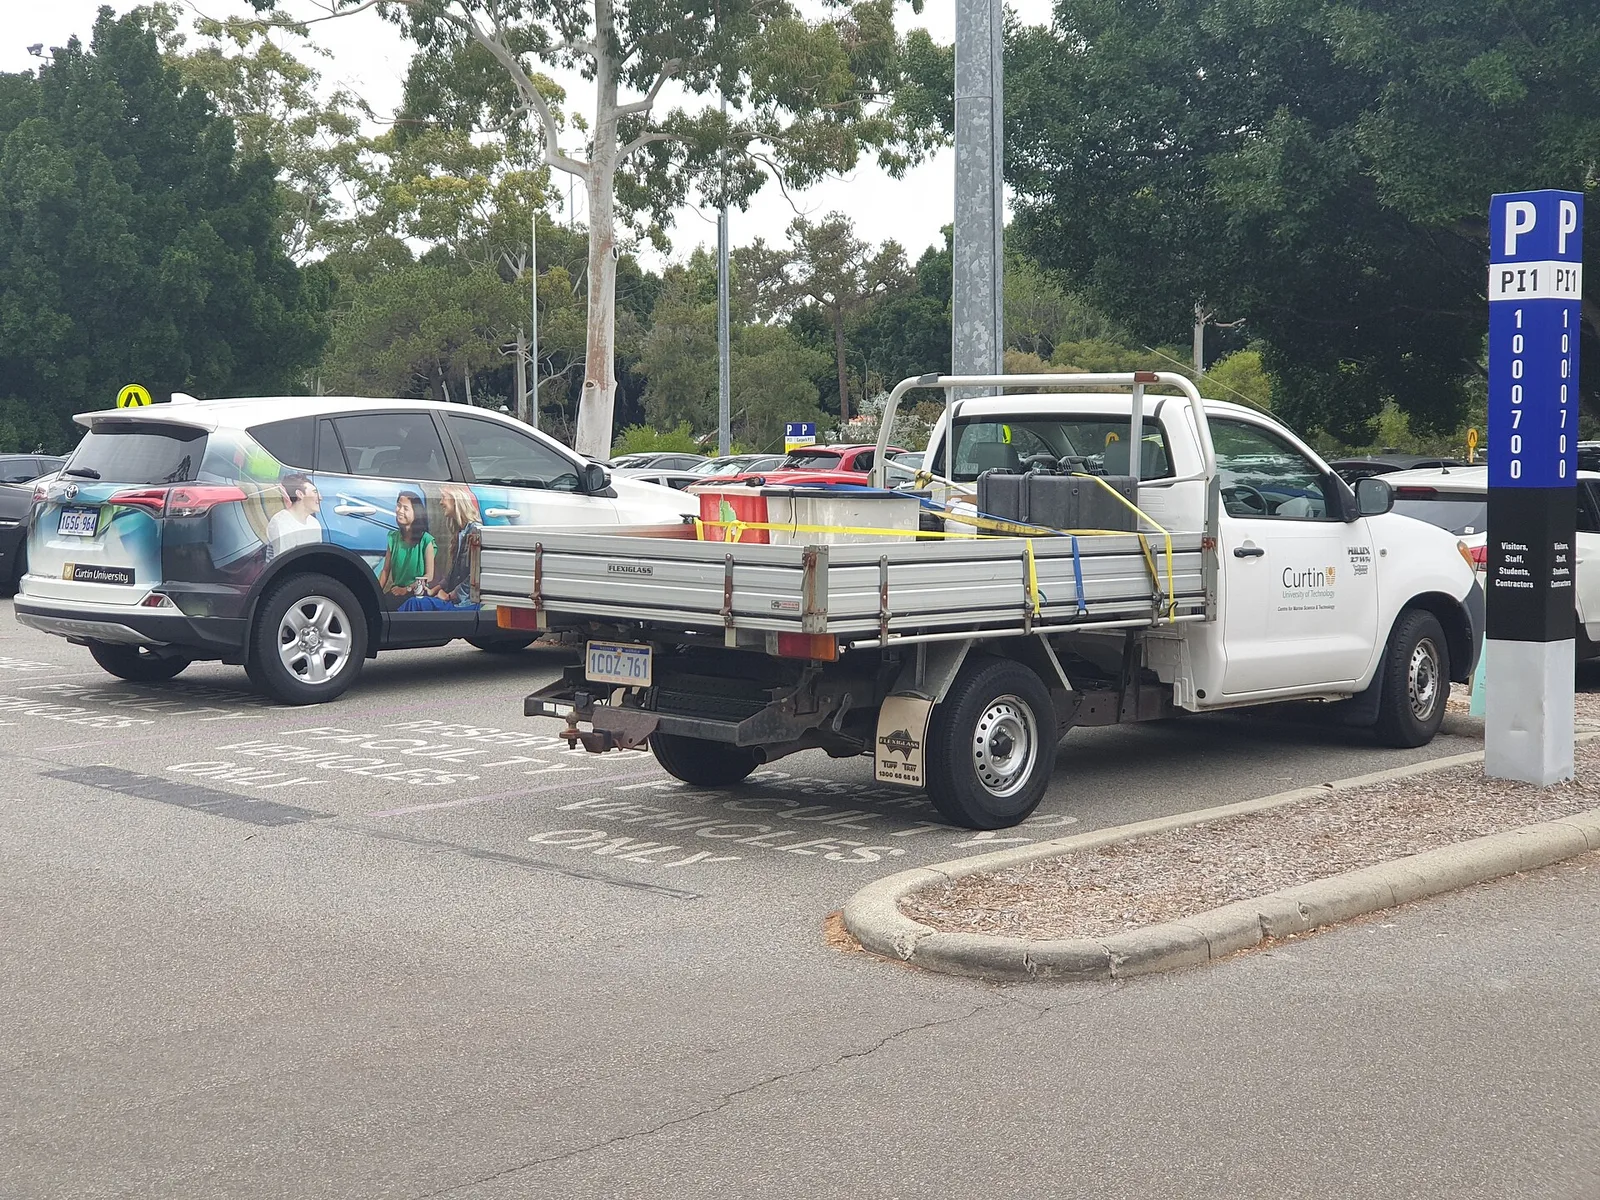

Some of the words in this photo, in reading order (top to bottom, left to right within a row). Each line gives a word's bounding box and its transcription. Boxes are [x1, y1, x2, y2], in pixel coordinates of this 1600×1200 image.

[1504, 201, 1537, 255] P
[1558, 200, 1577, 254] P
[787, 424, 793, 435] P
[802, 424, 807, 435] P
[1501, 542, 1529, 551] Visitors,
[1505, 554, 1524, 564] Staff,
[74, 568, 93, 579] Curtin
[93, 569, 129, 584] University
[608, 565, 652, 574] FLEXIGLASS
[1283, 567, 1325, 588] Curtin
[1499, 566, 1531, 576] Students,
[1495, 579, 1534, 588] Contractors
[1282, 590, 1304, 600] University
[1310, 589, 1335, 599] Technology
[278, 727, 598, 775] FACULTY
[215, 740, 481, 786] VEHICLES
[165, 761, 331, 789] ONLY
[556, 797, 906, 864] VEHICLES
[527, 829, 742, 868] ONLY
